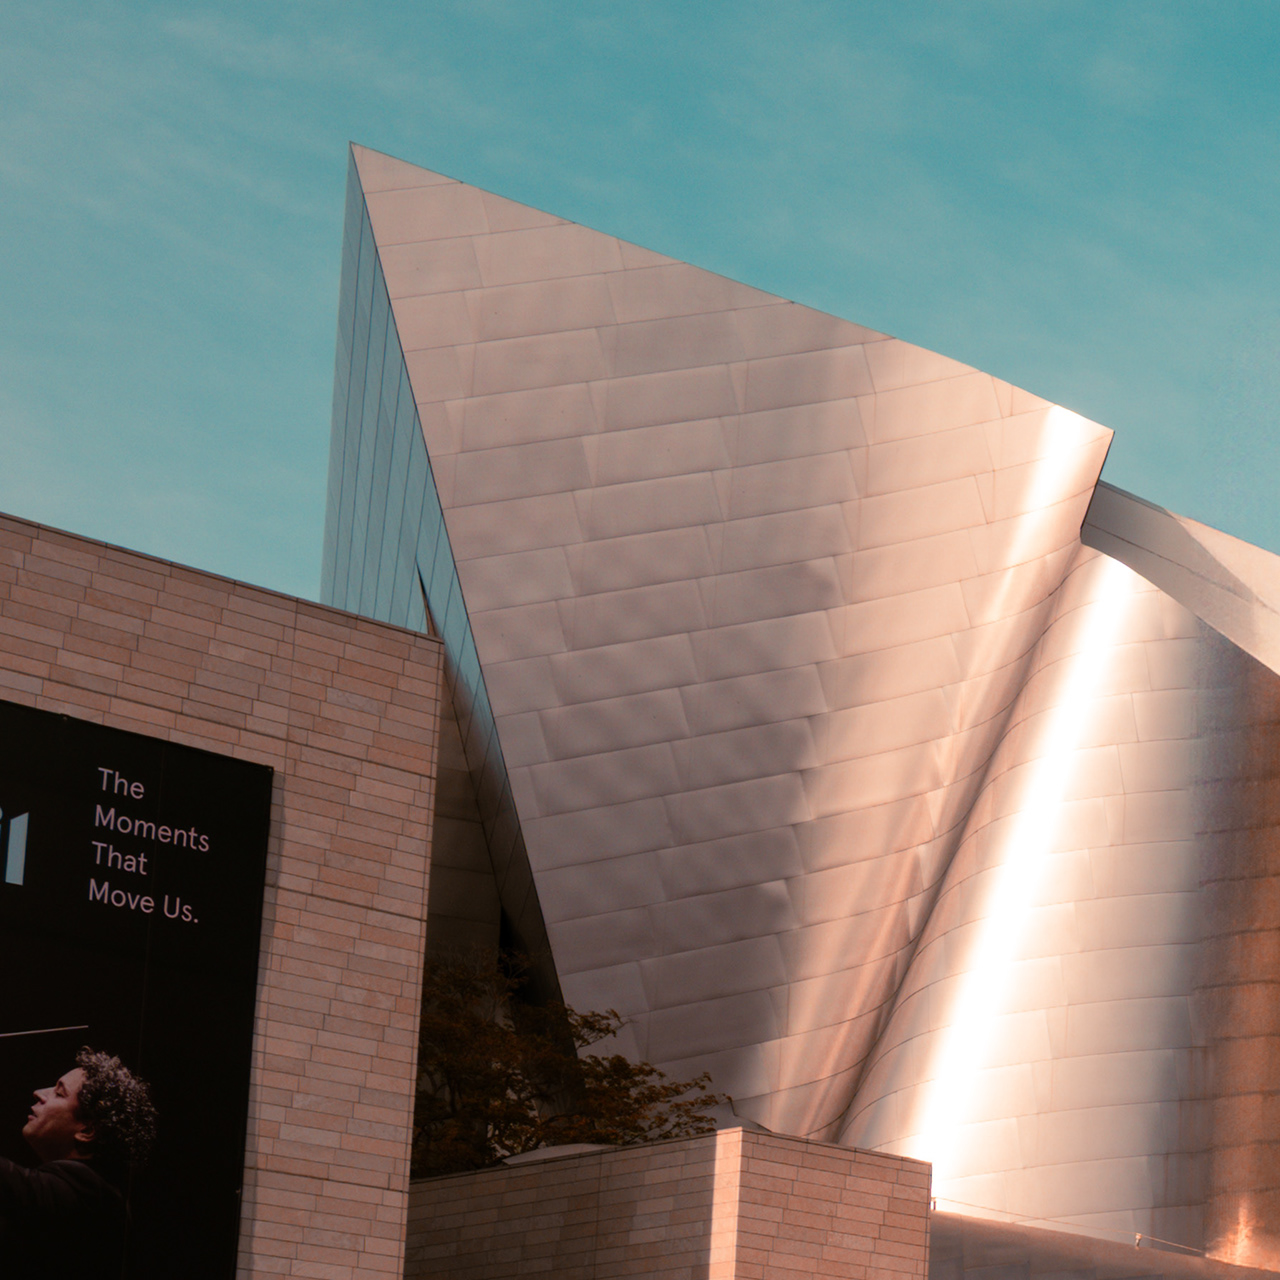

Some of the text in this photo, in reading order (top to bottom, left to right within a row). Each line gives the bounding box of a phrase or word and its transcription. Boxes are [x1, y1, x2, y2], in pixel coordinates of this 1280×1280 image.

[97, 767, 145, 799] The
[94, 804, 210, 852] Moments
[91, 840, 148, 875] That
[88, 878, 199, 924] Move Us.
